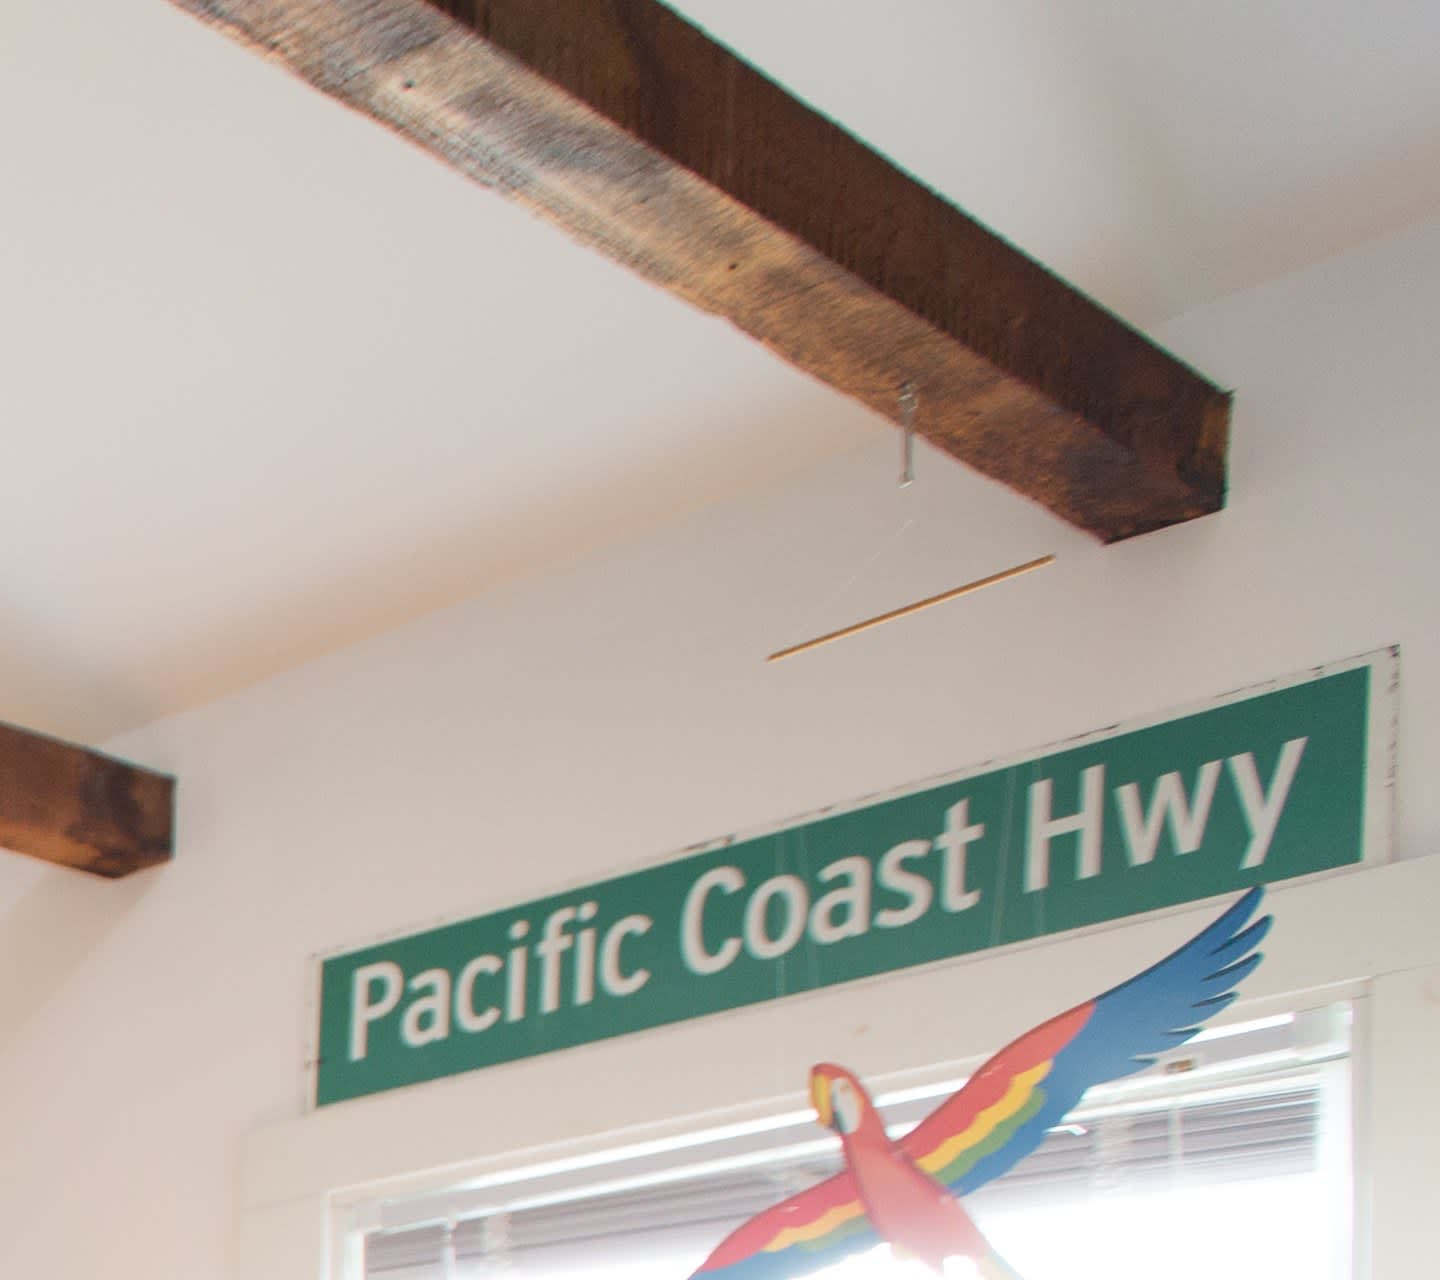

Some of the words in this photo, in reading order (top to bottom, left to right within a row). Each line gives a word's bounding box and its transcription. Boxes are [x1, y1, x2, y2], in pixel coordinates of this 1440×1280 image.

[349, 901, 653, 1062] Pacific
[681, 799, 983, 977] Coast
[1023, 736, 1310, 892] Hwy
